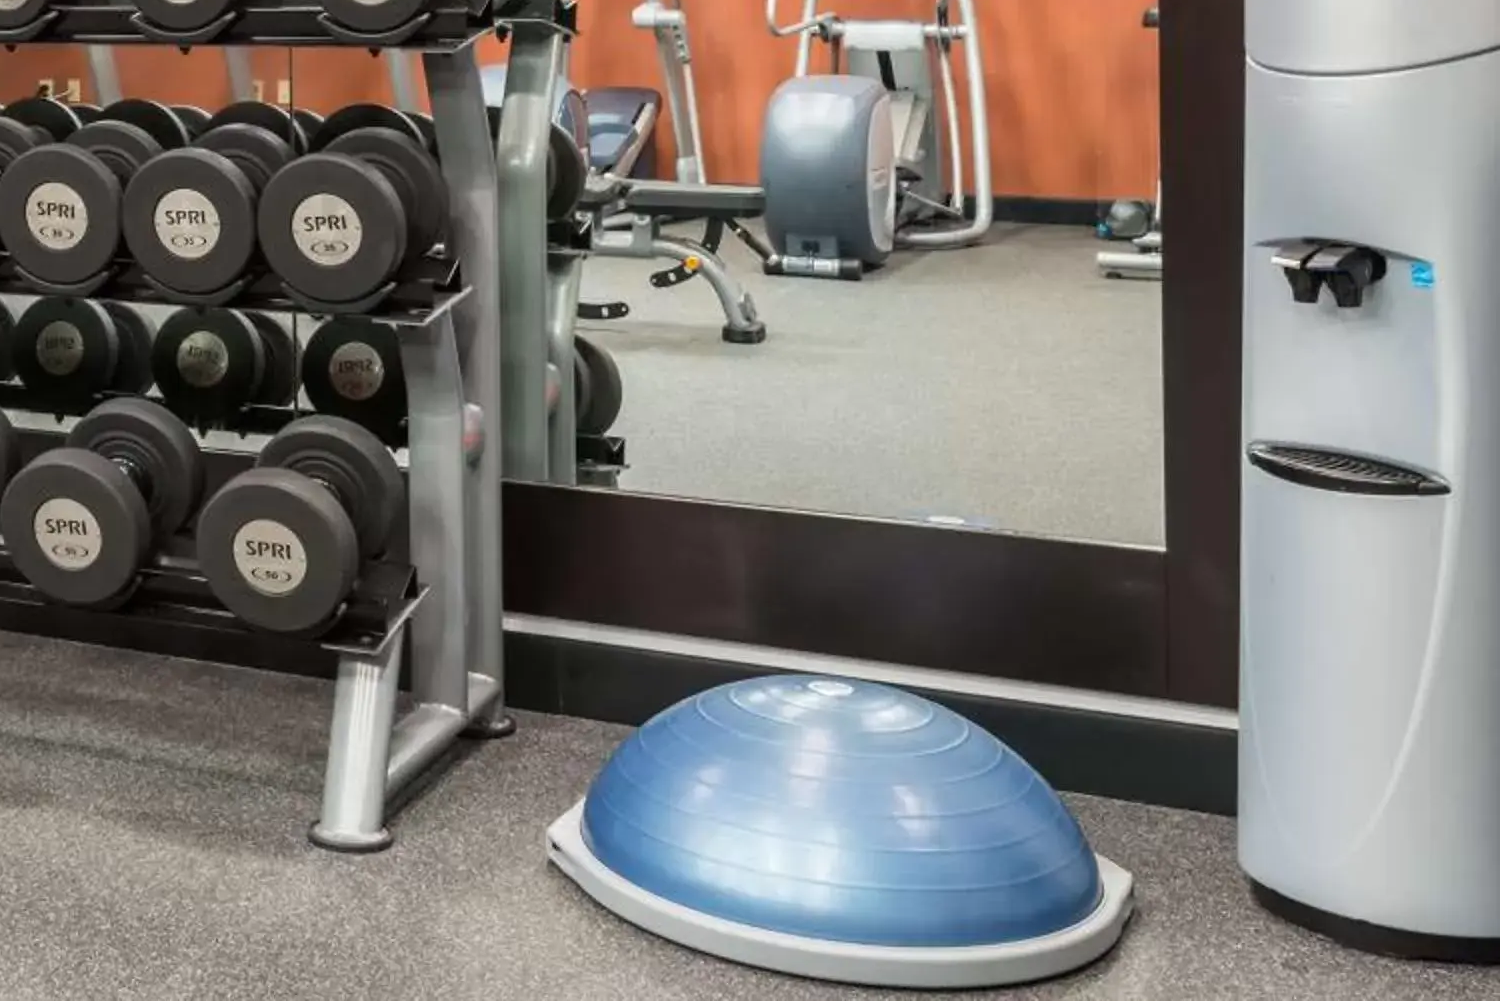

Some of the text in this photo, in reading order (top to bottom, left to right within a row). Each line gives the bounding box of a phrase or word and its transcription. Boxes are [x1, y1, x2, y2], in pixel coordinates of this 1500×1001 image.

[36, 201, 75, 219] SPRI
[164, 209, 206, 225] SPRI
[303, 214, 348, 232] SPRI
[45, 518, 88, 536] SPRI
[245, 540, 292, 560] SPRI
